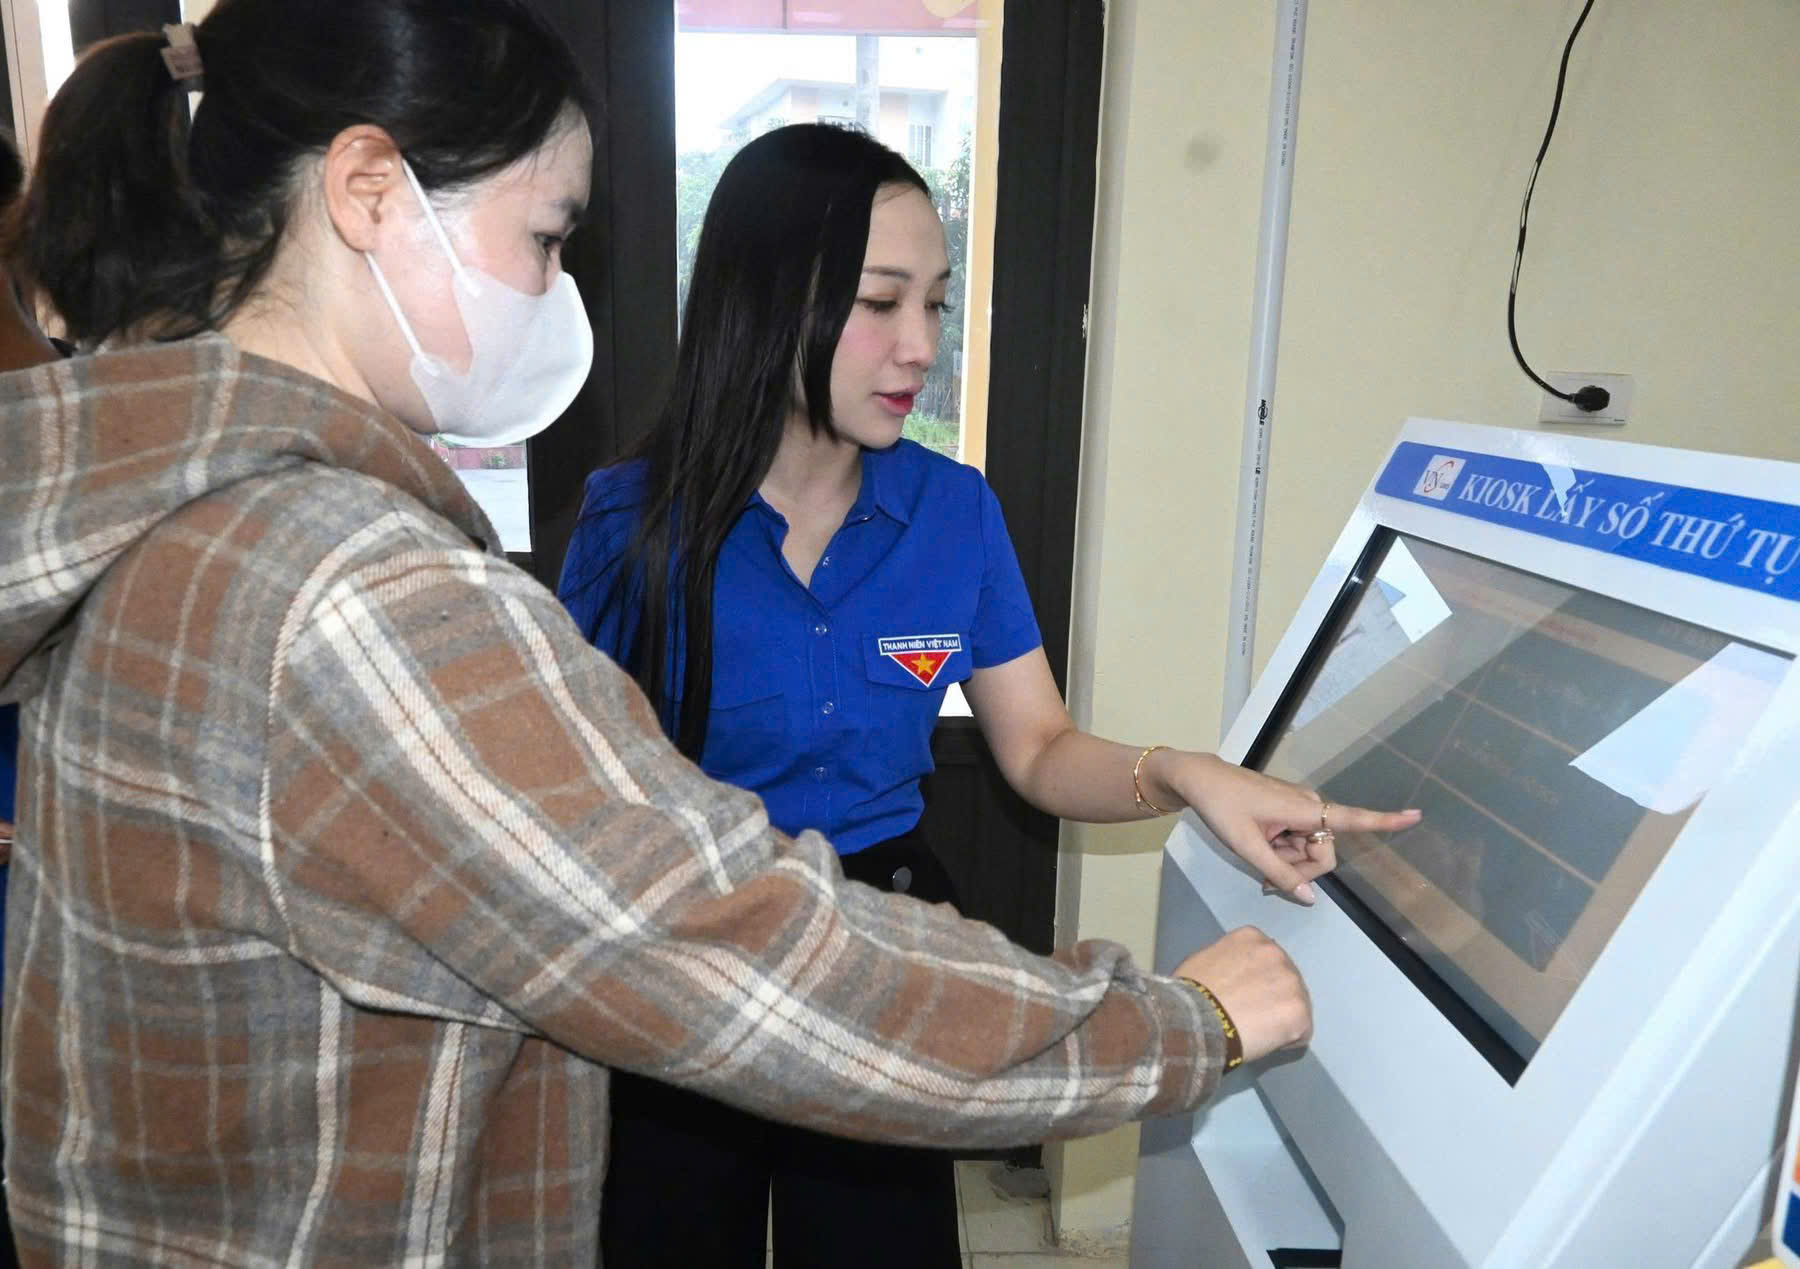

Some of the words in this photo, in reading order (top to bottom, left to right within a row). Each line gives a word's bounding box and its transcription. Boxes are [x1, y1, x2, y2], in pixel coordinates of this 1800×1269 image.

[1458, 474, 1542, 514] KIOSK
[1534, 479, 1606, 528] LẤY
[1597, 491, 1664, 539] SỐ
[1650, 512, 1746, 559] THỨ
[882, 642, 907, 650] THANH
[908, 639, 925, 649] NIÊN
[926, 638, 942, 649] VIỆT
[943, 639, 958, 648] NAM
